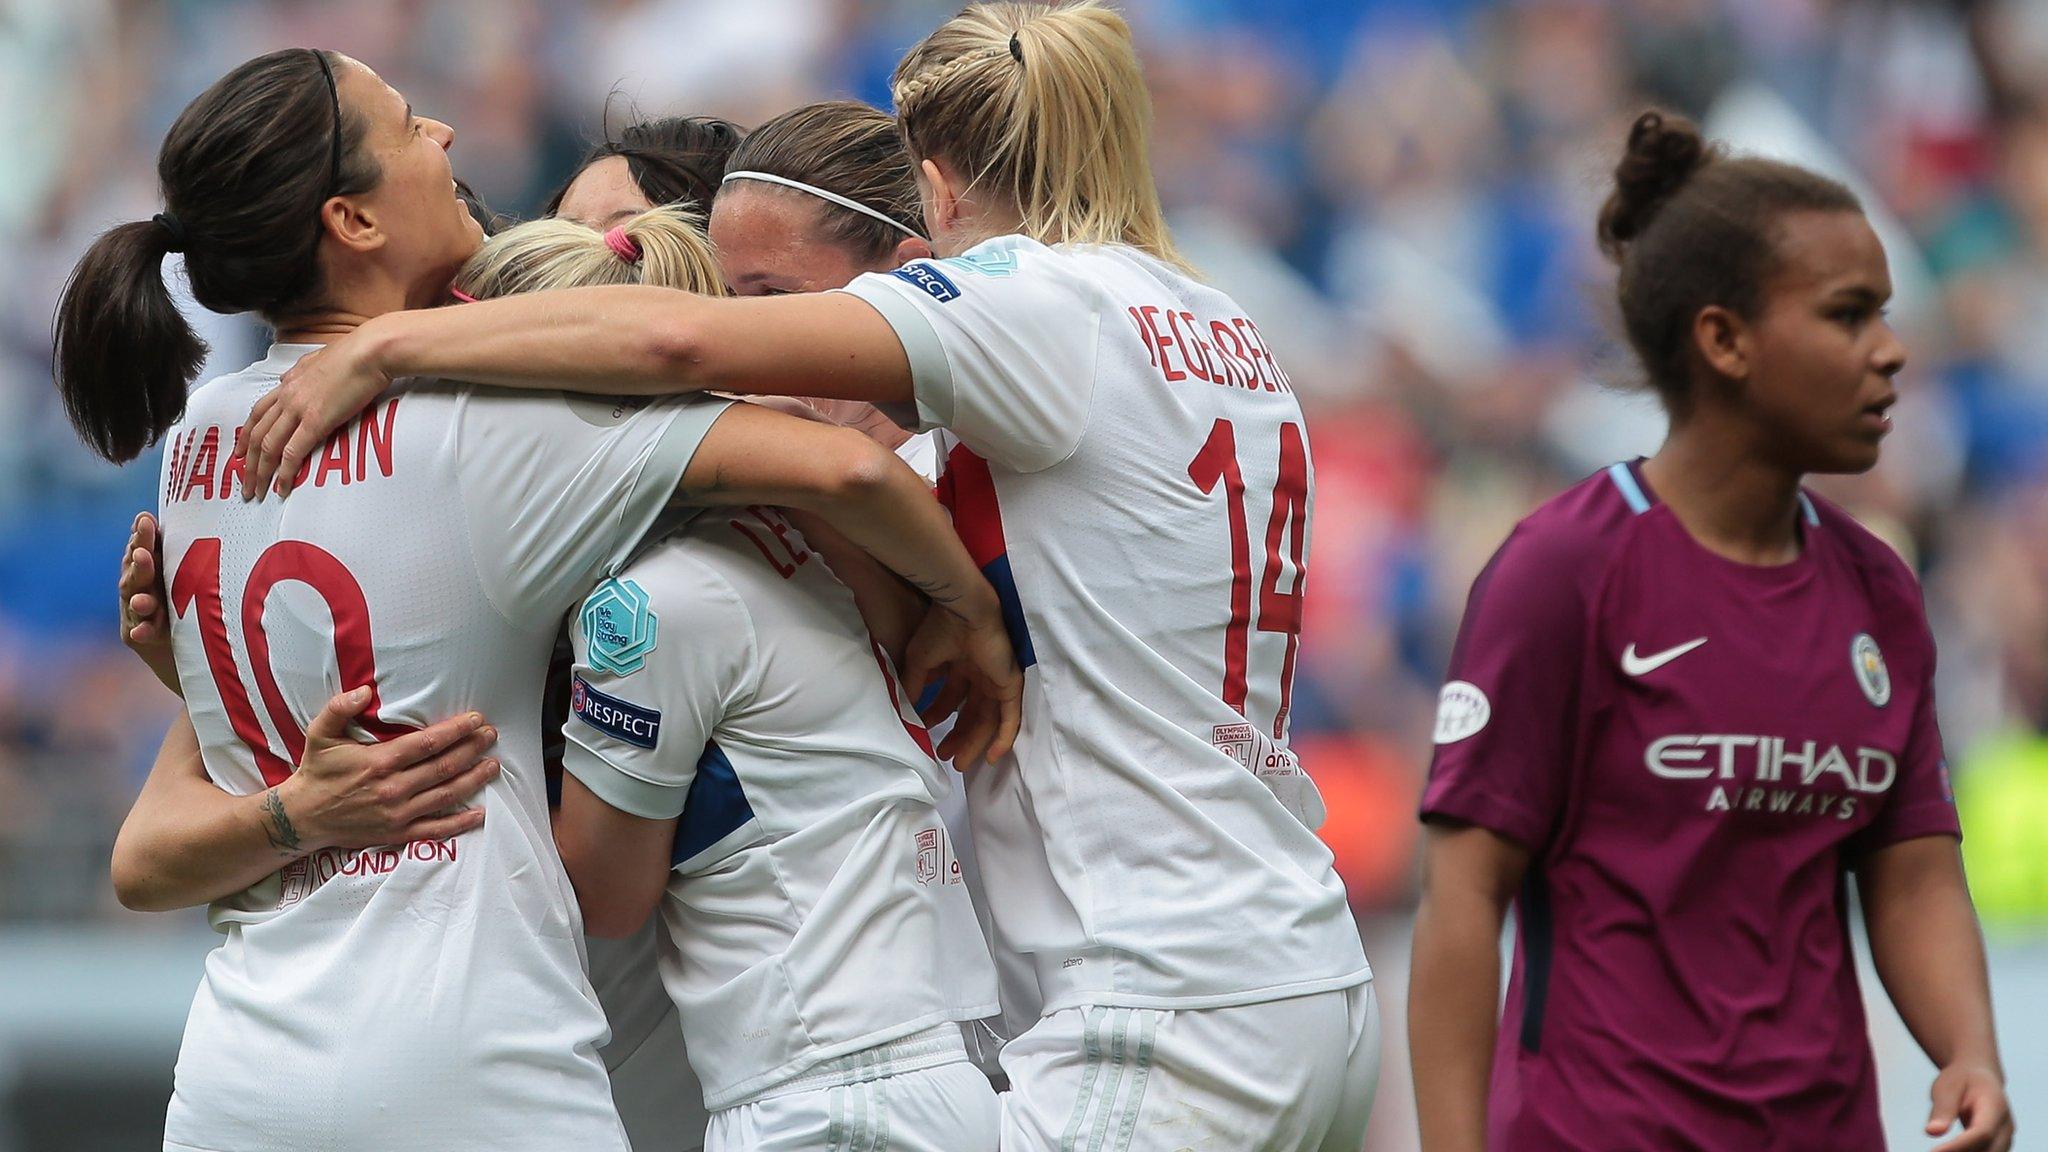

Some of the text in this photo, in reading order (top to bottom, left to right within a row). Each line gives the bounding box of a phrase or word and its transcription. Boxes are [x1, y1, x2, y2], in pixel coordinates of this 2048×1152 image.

[901, 264, 953, 301] SPECT
[1188, 417, 1308, 740] 14
[171, 536, 424, 789] 10
[585, 697, 658, 738] RESPECT
[1215, 725, 1250, 735] OLYMPIQUE
[1215, 732, 1252, 741] LYONNAIS
[1643, 734, 1897, 793] ETIHAD
[1705, 786, 1858, 820] AIRWAYS
